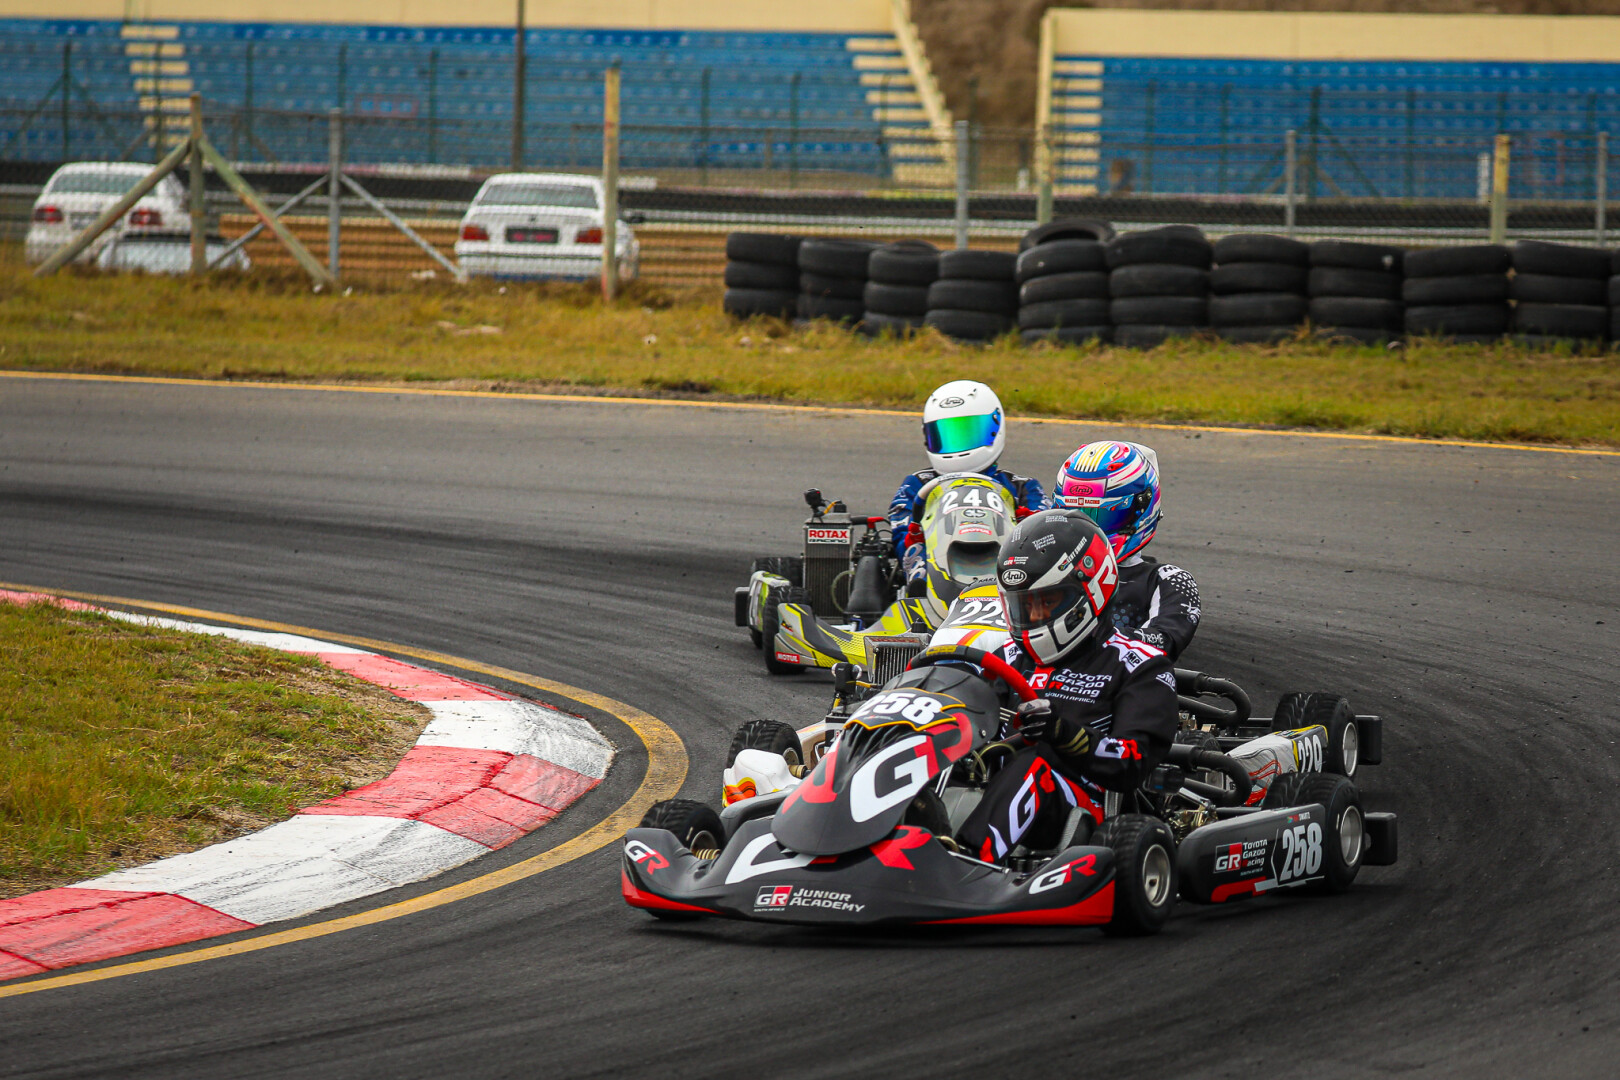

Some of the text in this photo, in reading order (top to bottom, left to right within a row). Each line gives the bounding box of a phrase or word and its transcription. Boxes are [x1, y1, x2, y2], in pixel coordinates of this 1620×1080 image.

[1072, 485, 1090, 494] Arai
[942, 488, 1004, 514] 246
[809, 530, 848, 539] ROTAX
[1004, 571, 1022, 580] Arai
[777, 653, 799, 662] MOTUL
[1053, 675, 1105, 688] GAZOO
[1061, 668, 1112, 682] TOYOTA
[1048, 681, 1101, 698] Racing
[1094, 736, 1143, 760] GR
[849, 712, 974, 824] GR
[1008, 756, 1057, 845] GR
[1242, 839, 1268, 850] TOYOTA
[624, 840, 670, 875] GR
[1242, 848, 1266, 859] GAZOO
[1279, 822, 1323, 882] 258
[1215, 854, 1241, 871] GR
[1029, 854, 1097, 895] GR
[756, 893, 788, 906] GR
[793, 888, 852, 901] JUNIOR
[789, 897, 865, 912] ACADEMY
